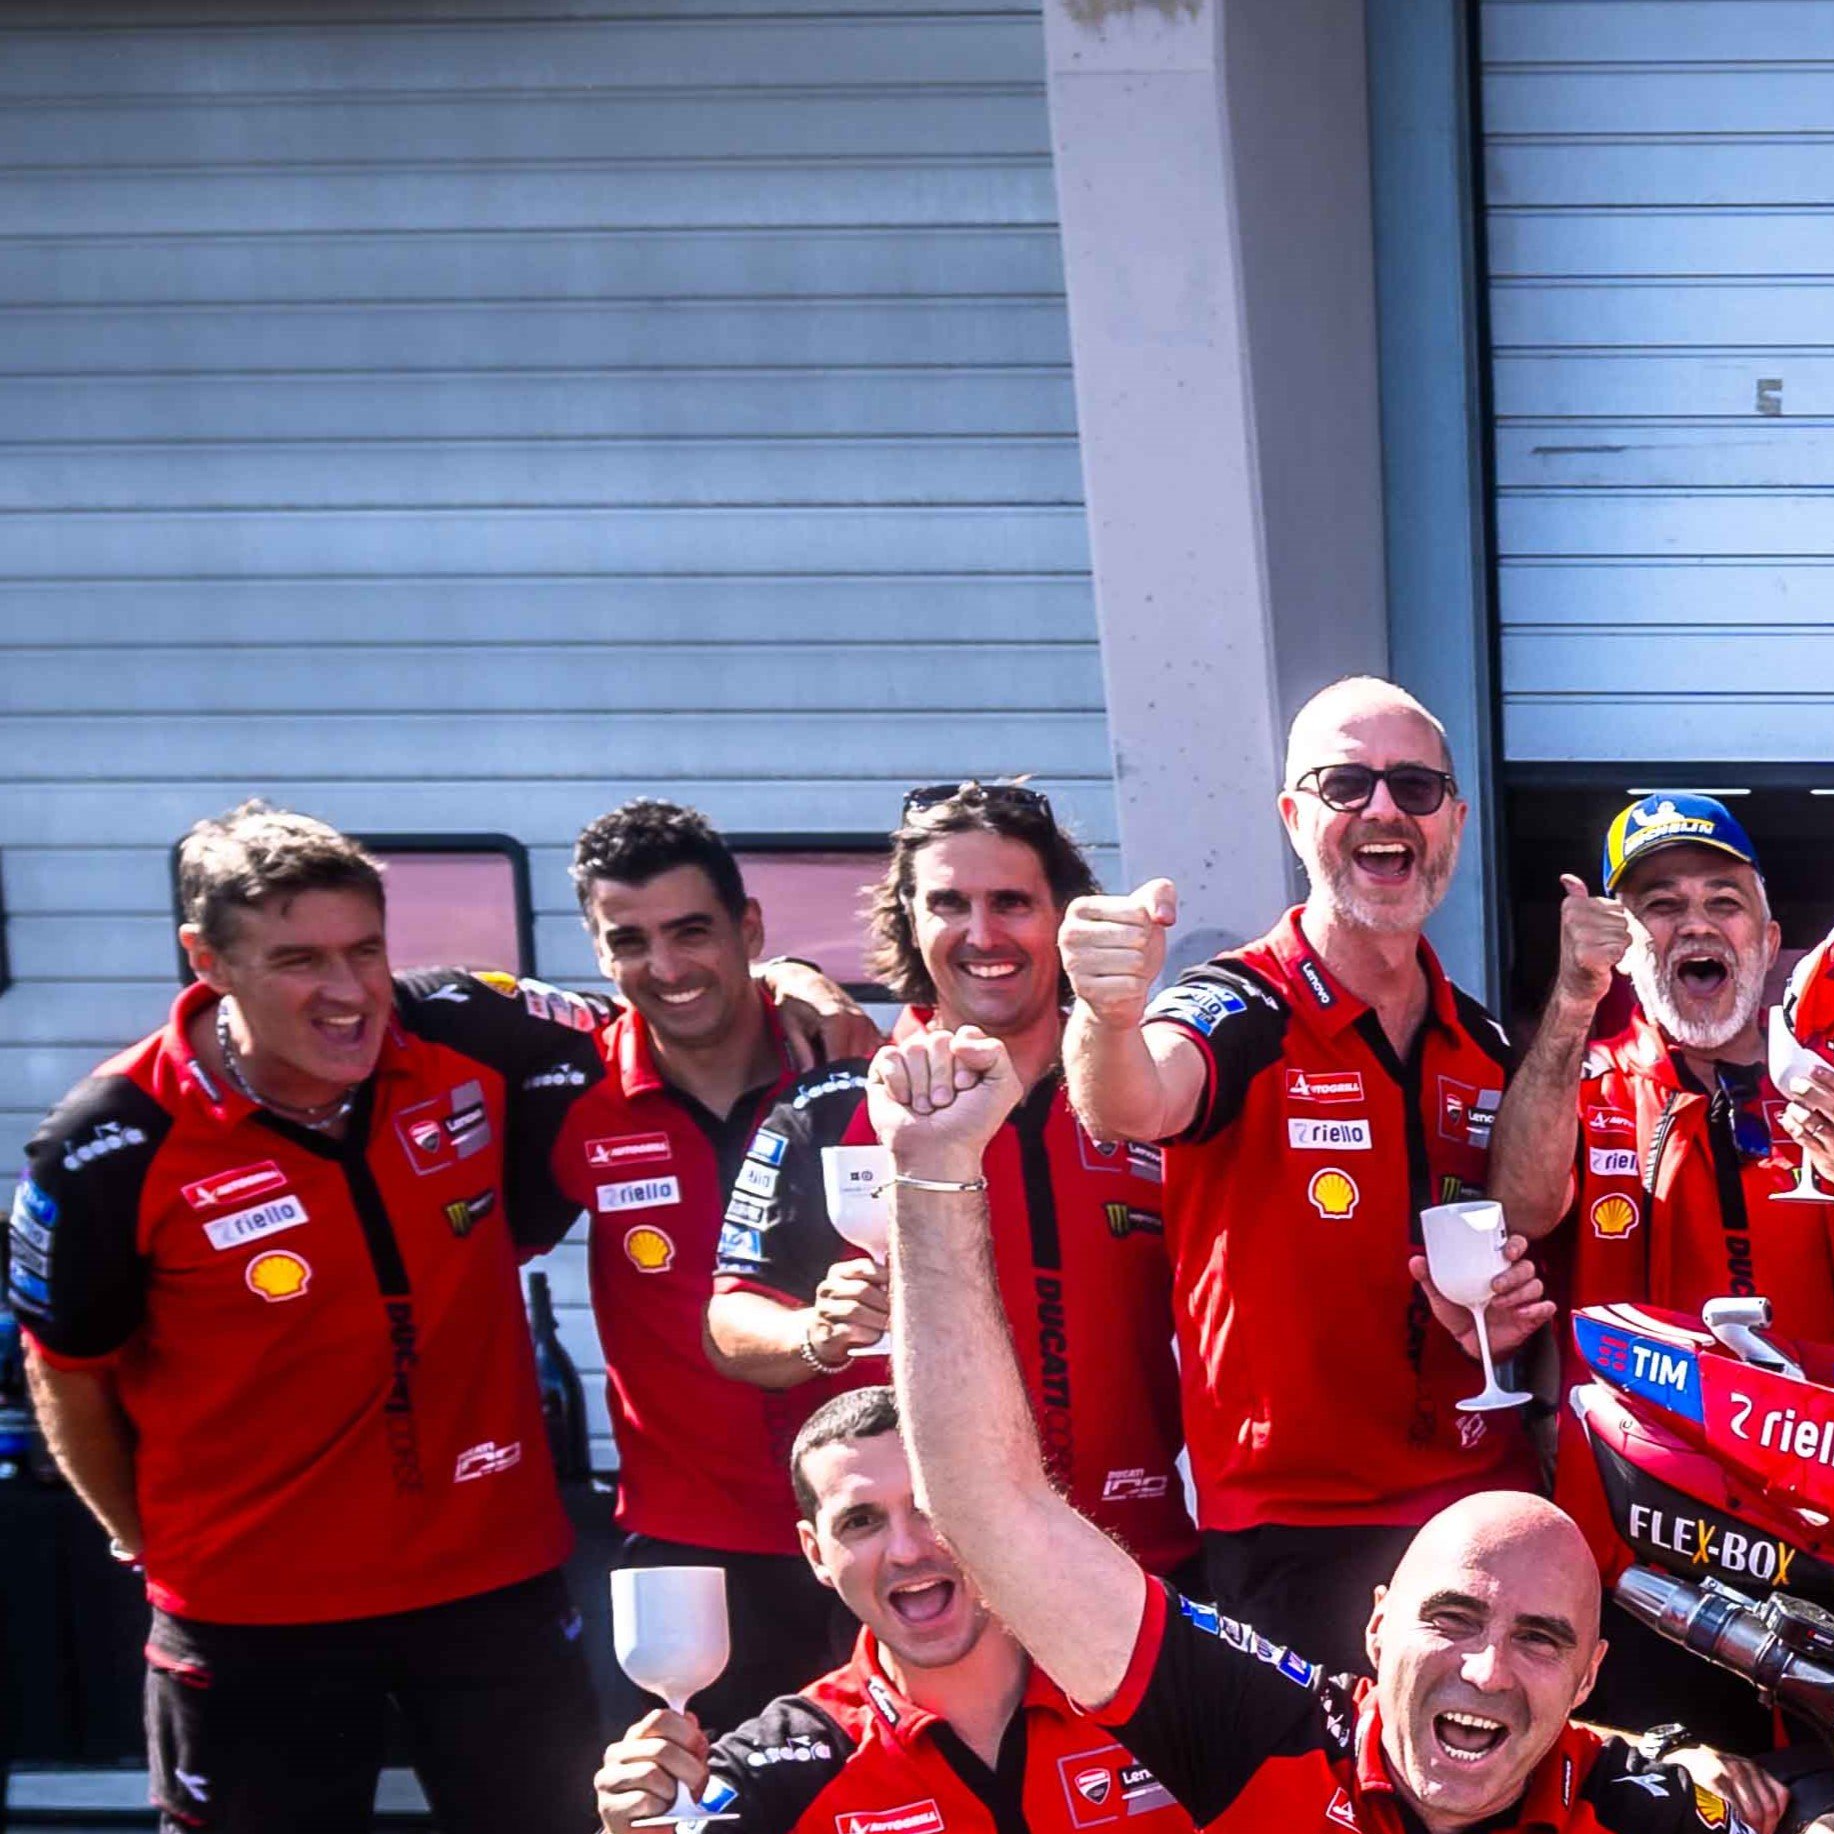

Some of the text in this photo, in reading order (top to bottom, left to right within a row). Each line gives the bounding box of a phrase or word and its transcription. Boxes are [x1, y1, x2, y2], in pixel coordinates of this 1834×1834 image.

[1303, 962, 1330, 1003] Lenovo
[1313, 1125, 1364, 1143] riello
[1469, 1108, 1496, 1123] Leno
[620, 1184, 672, 1204] riello
[234, 1202, 295, 1236] riello
[1731, 1236, 1755, 1297] DUC
[1035, 1276, 1070, 1408] DUCATI
[1632, 1345, 1688, 1391] TIM
[1629, 1502, 1797, 1588] FLEX-BOX
